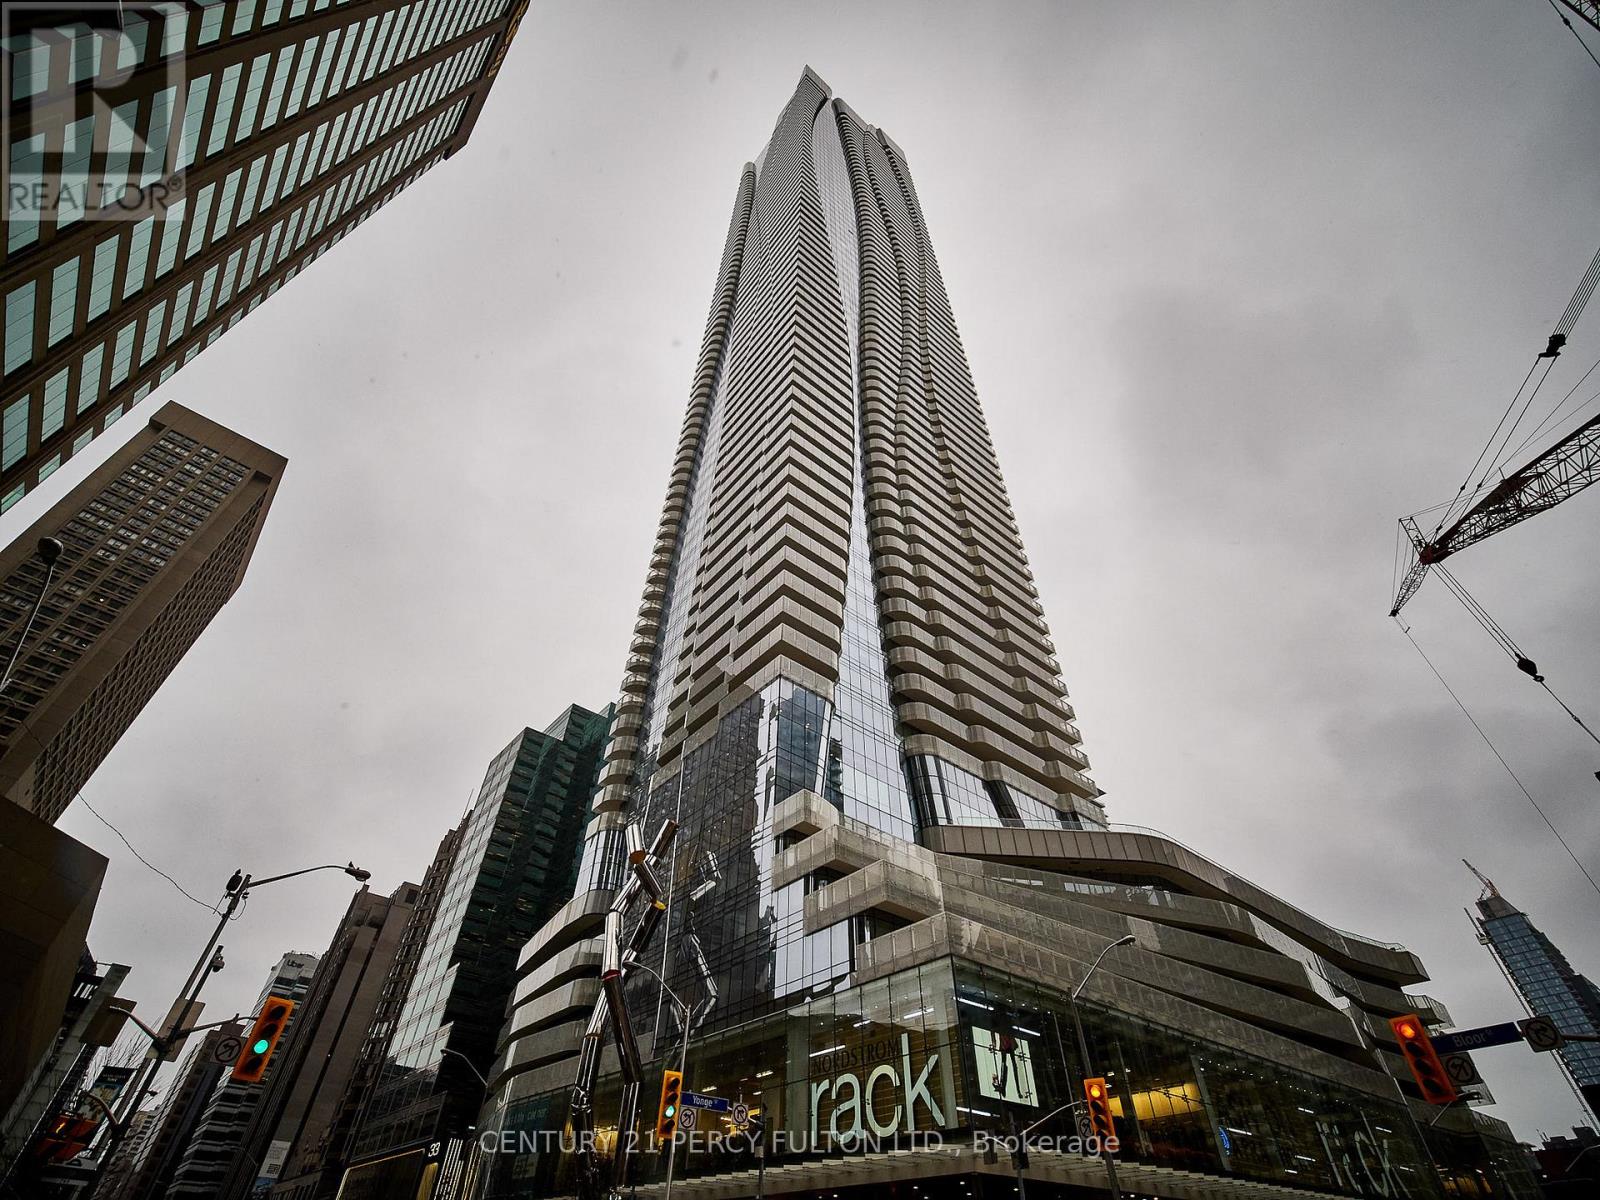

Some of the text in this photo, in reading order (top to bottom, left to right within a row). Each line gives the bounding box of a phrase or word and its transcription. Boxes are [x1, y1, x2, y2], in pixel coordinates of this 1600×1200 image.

[1453, 1031, 1487, 1048] Bloor
[812, 1038, 900, 1075] NORDSTROM
[810, 1032, 946, 1147] rack
[692, 1095, 713, 1108] Yonge
[428, 1141, 440, 1158] 33
